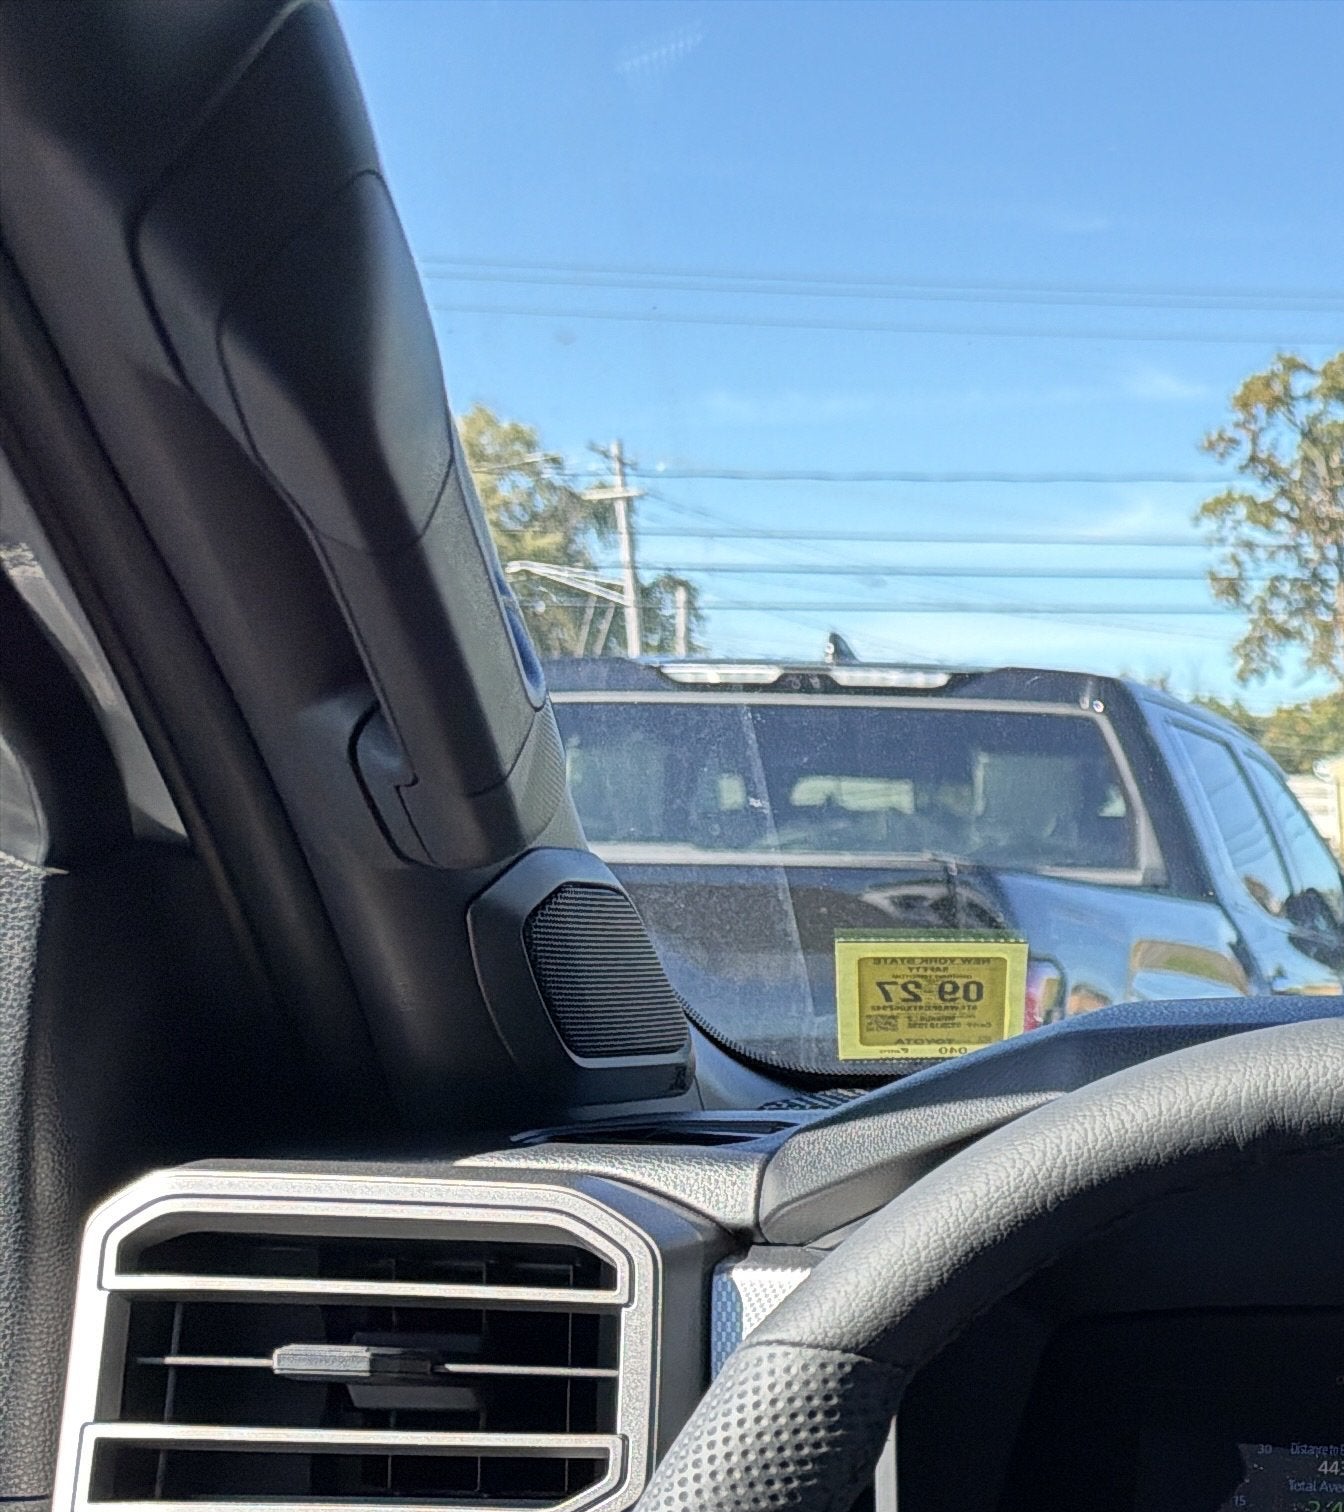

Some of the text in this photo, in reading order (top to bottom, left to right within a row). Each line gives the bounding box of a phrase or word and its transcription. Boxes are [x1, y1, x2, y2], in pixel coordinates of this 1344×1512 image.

[1256, 1444, 1273, 1455] 30
[1290, 1443, 1329, 1457] Distance
[1287, 1478, 1318, 1493] Total
